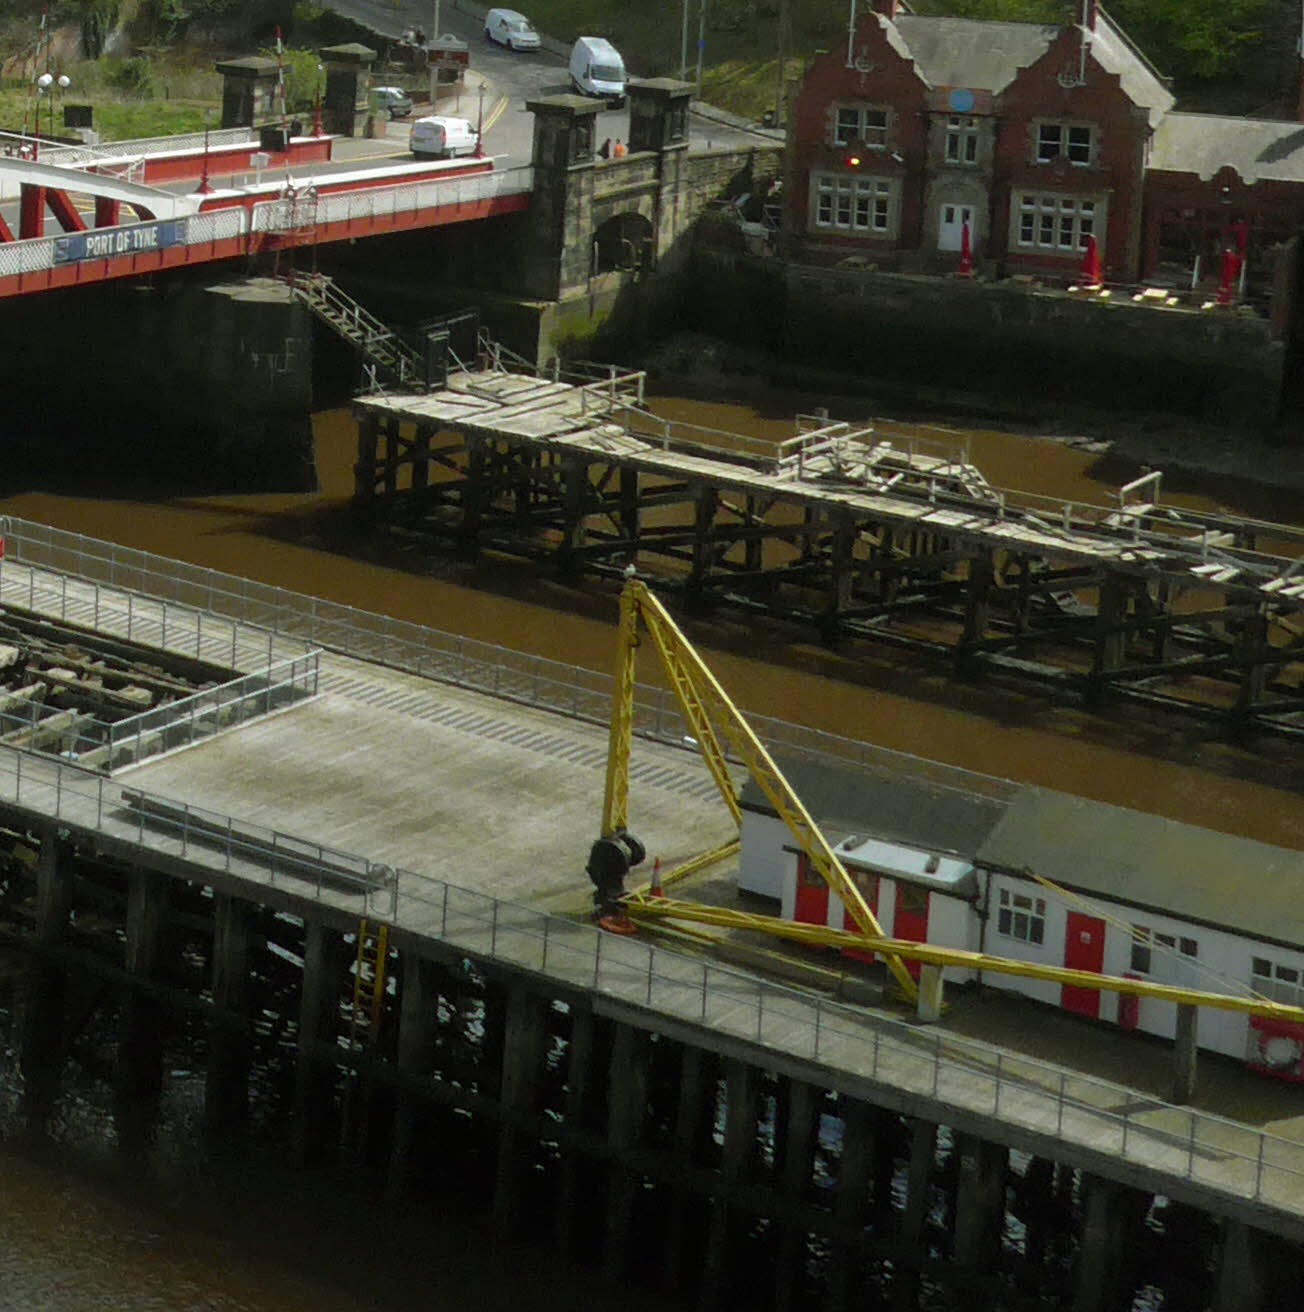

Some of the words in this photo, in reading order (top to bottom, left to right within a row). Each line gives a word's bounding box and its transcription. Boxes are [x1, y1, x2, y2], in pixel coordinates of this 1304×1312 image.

[86, 234, 114, 257] PORT
[116, 231, 130, 251] OF
[134, 227, 158, 247] TYNE
